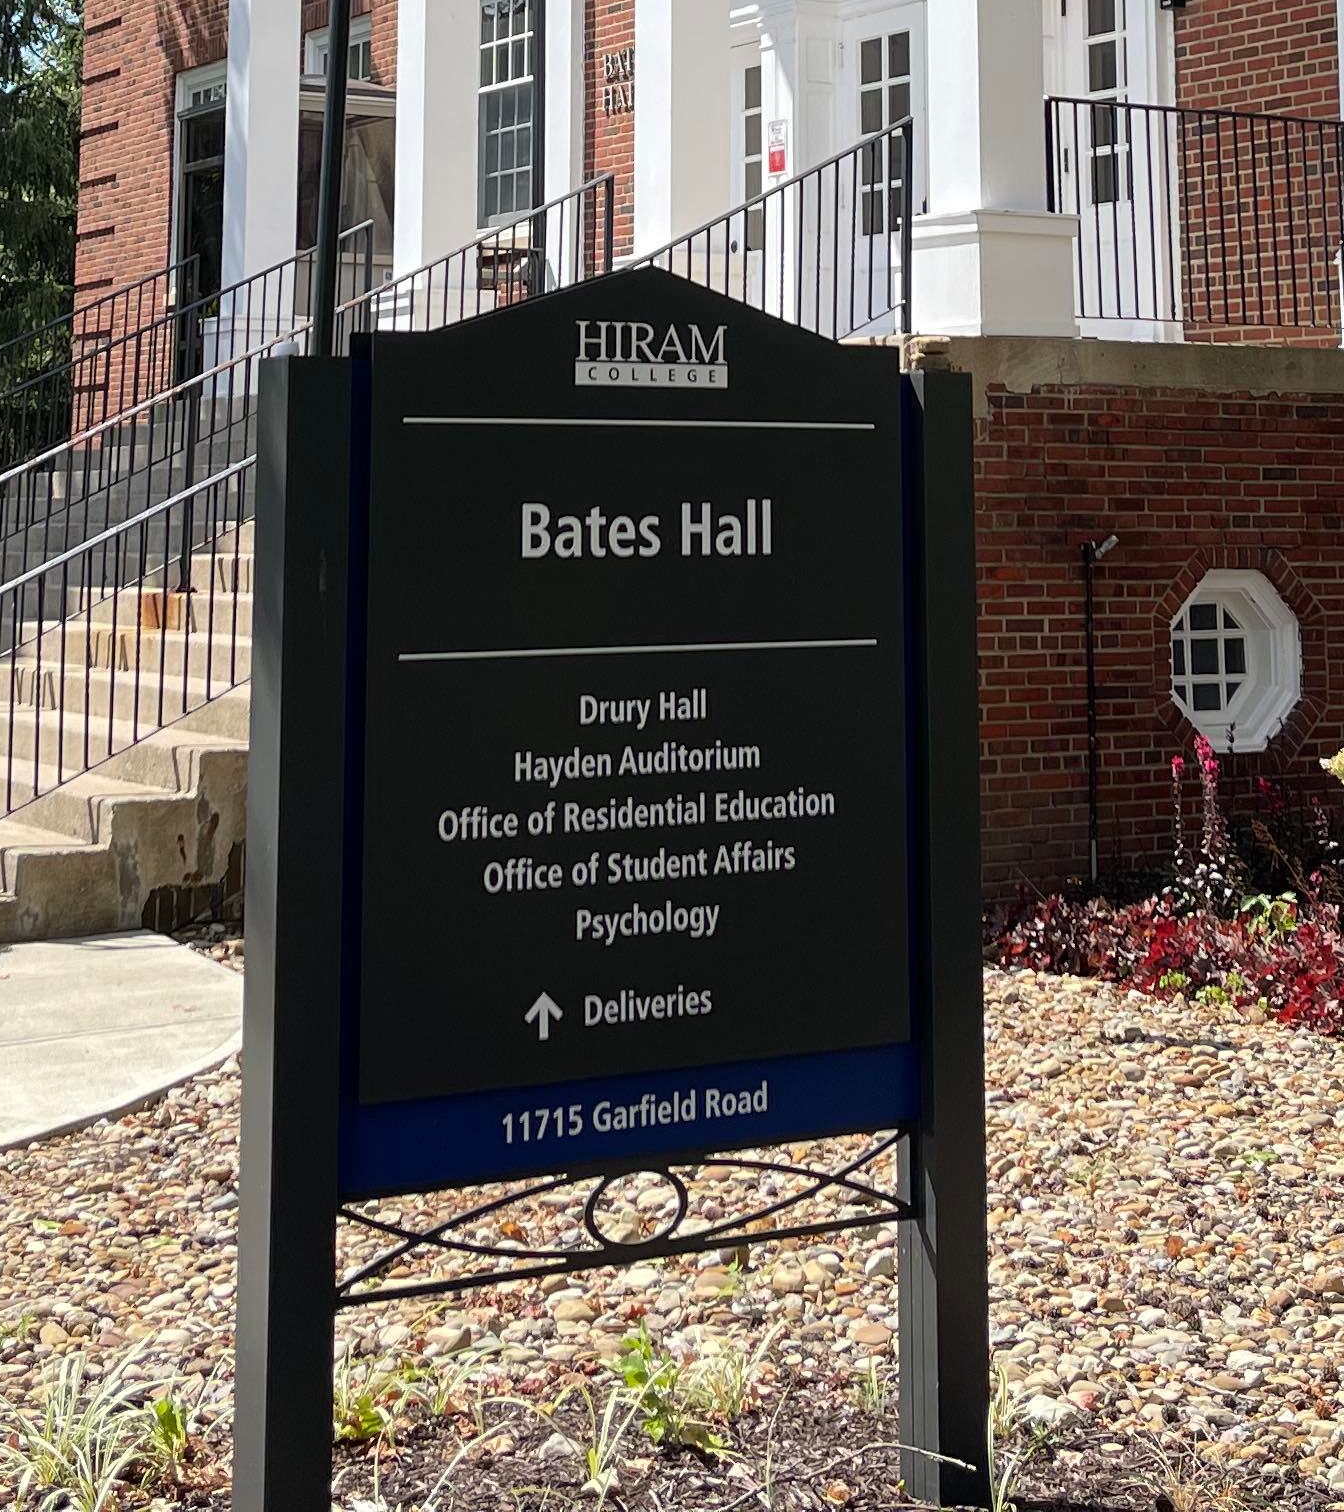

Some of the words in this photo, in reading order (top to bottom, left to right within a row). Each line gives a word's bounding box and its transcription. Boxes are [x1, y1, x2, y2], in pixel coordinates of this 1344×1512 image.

[602, 46, 635, 80] BAT
[601, 82, 635, 112] HAL
[575, 320, 728, 365] HIRAM
[587, 365, 717, 384] COLLEGE
[521, 503, 661, 558] Bates
[681, 499, 773, 556] Hall
[580, 695, 651, 730] Drury
[659, 689, 708, 721] Hall
[514, 746, 612, 788] Hayden
[619, 739, 761, 776] Auditorium
[438, 803, 519, 842] Office
[528, 802, 556, 836] of
[564, 792, 706, 833] Residential
[715, 787, 836, 822] Education
[483, 855, 563, 894] Office
[571, 851, 600, 886] of
[607, 847, 708, 884] Student
[713, 840, 797, 875] Affairs
[576, 901, 720, 946] Psychology
[584, 985, 713, 1027] Deliveries
[502, 1104, 584, 1144] 11715
[592, 1089, 697, 1133] Garfield
[705, 1080, 769, 1120] Road
